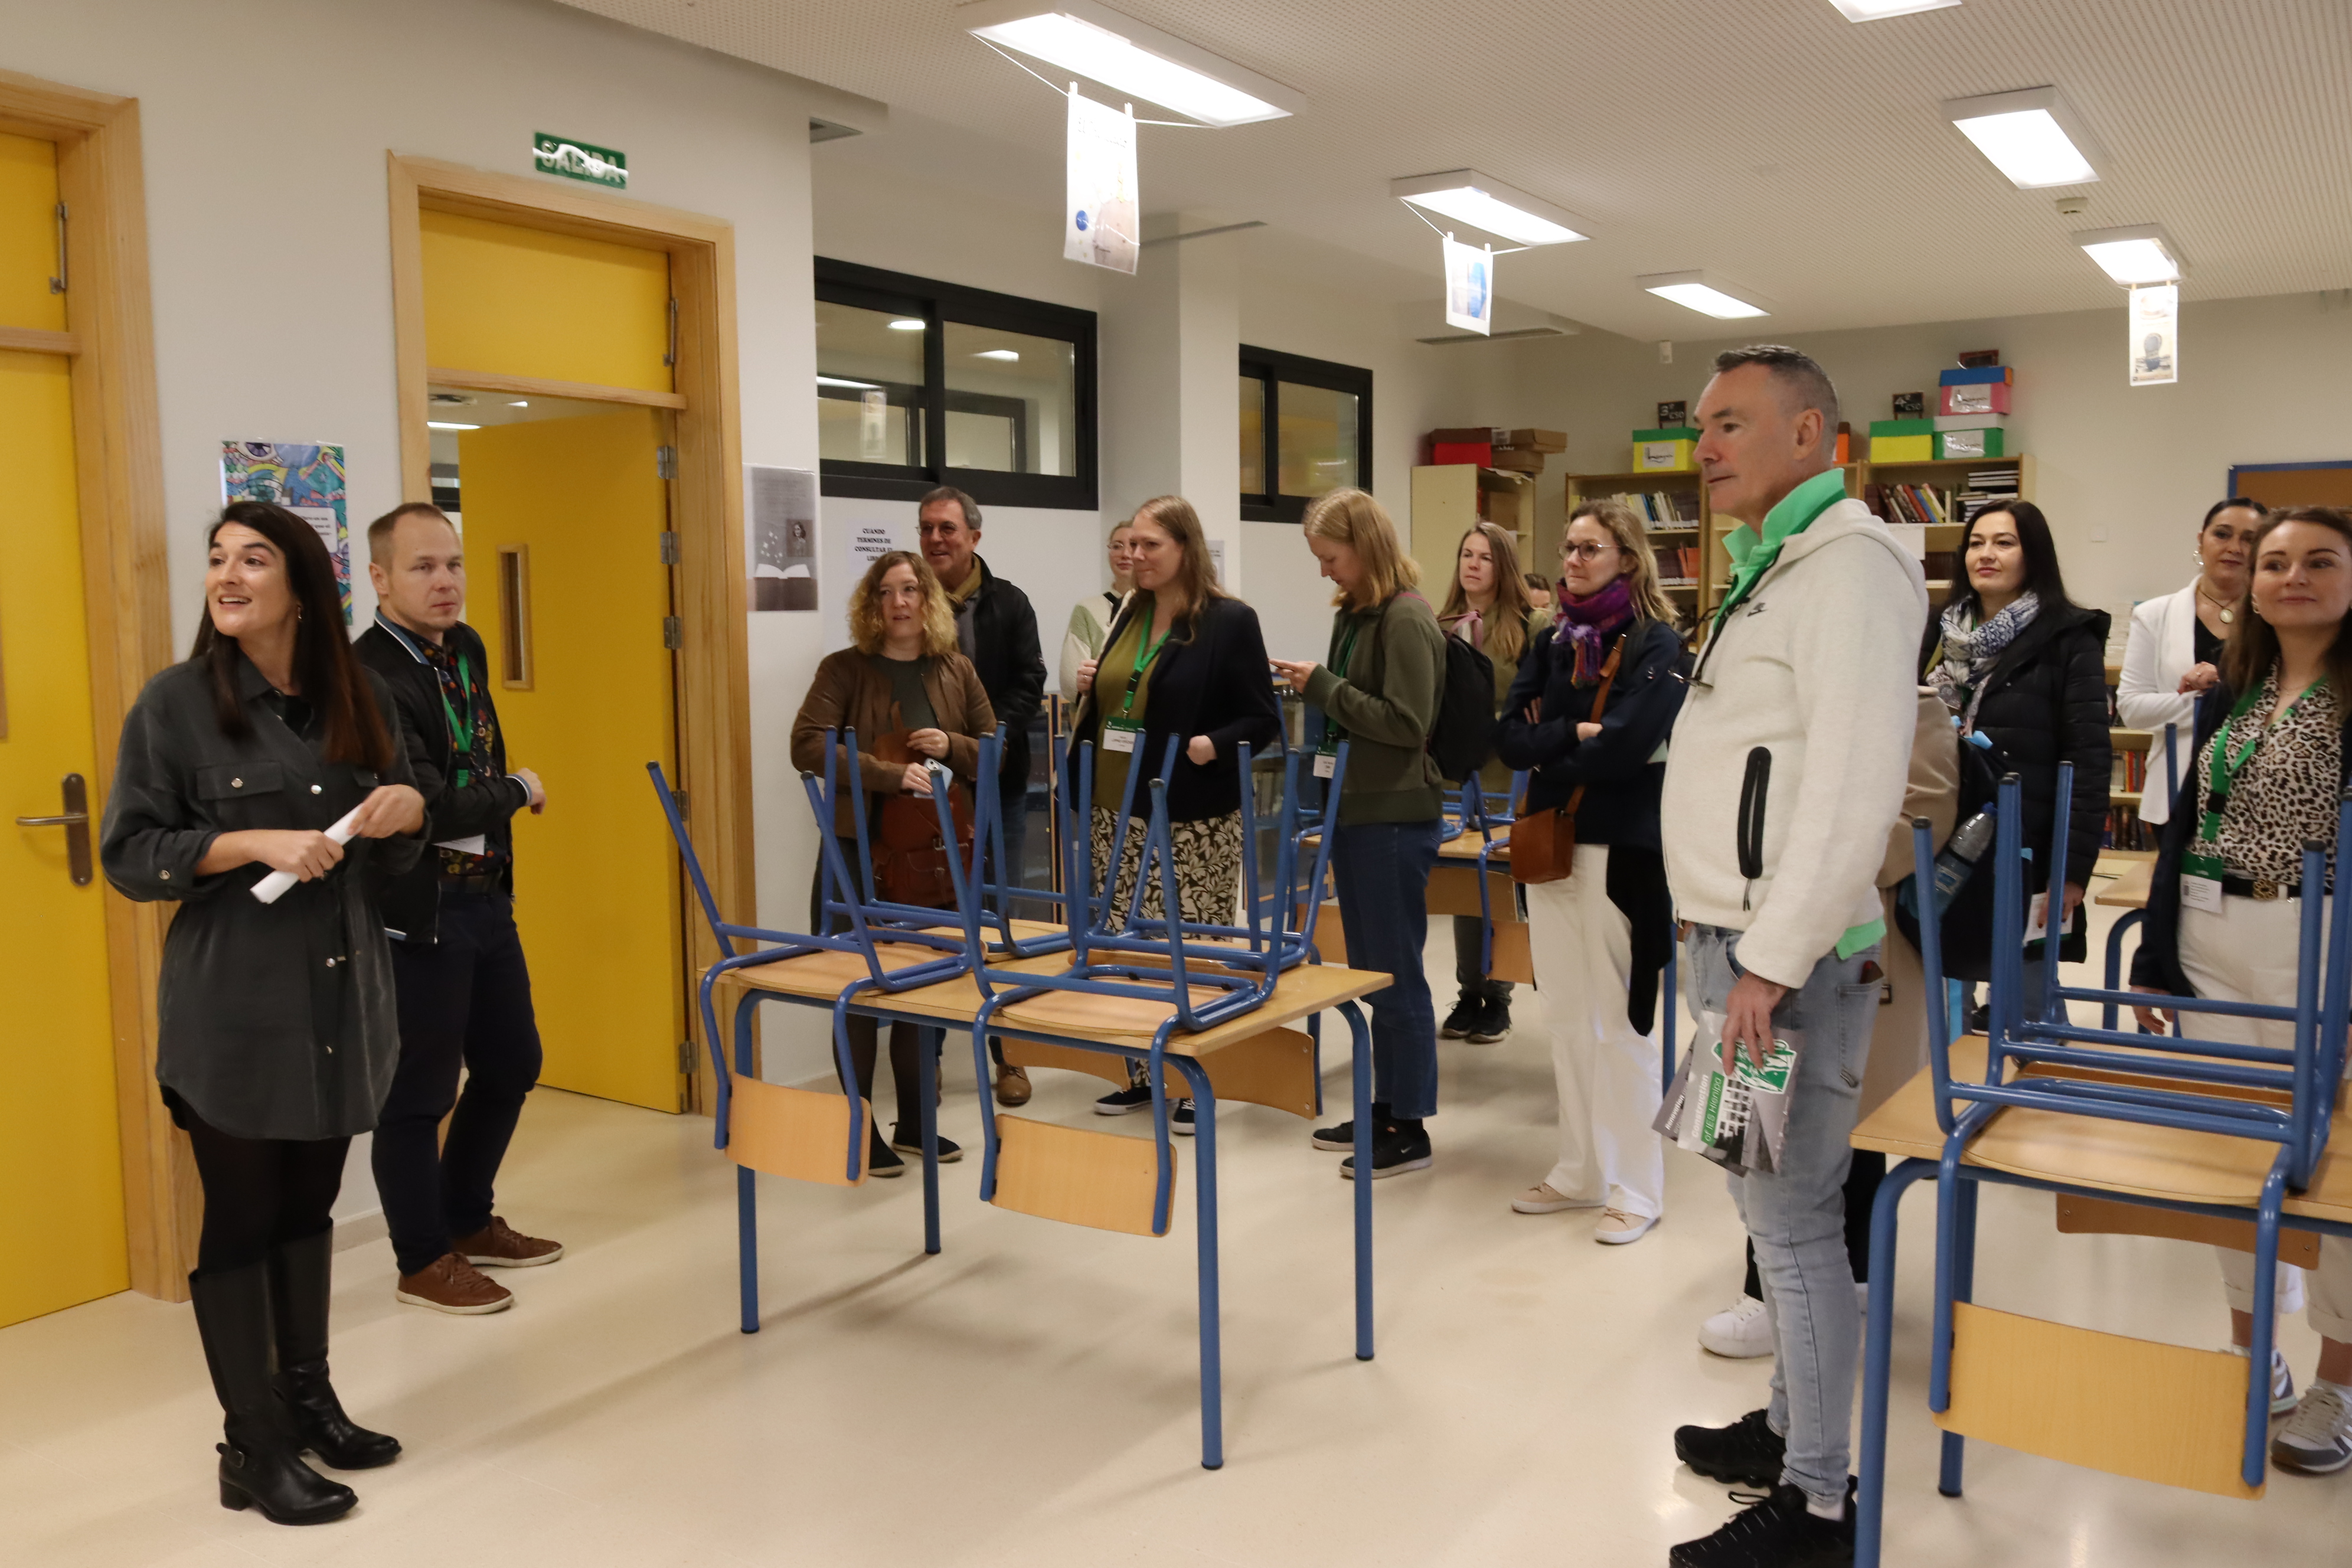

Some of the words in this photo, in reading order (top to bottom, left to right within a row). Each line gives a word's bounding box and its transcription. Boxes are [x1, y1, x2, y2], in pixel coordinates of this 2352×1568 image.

[1665, 1094, 1685, 1131] Renovation
[1691, 1074, 1709, 1138] Construction
[1709, 1077, 1721, 1113] Hienipa
[1704, 1130, 1711, 1142] of
[1705, 1114, 1716, 1131] IES
